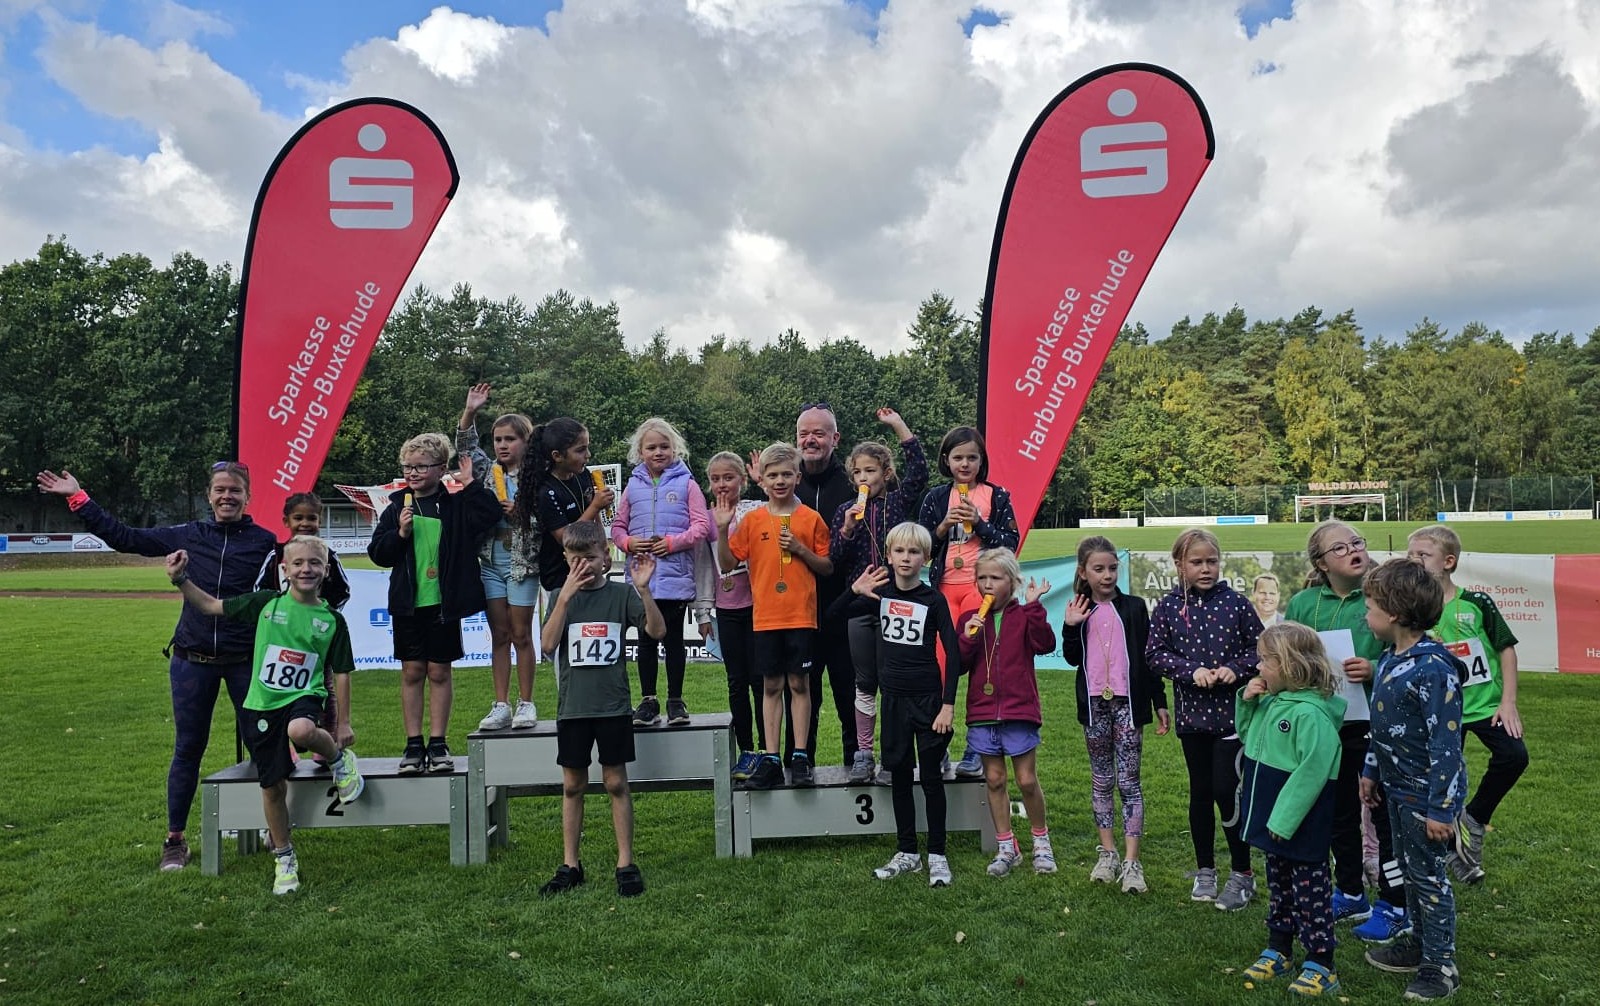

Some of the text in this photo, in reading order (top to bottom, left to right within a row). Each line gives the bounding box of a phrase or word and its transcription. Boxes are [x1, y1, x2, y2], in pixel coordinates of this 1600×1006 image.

[1015, 287, 1081, 397] Sparkasse
[1018, 249, 1134, 462] Harburg-Buxtehude
[268, 316, 331, 426] Sparkasse
[272, 281, 381, 491] Harburg-Buxtehude
[1308, 480, 1389, 491] WALDSTADION
[1495, 585, 1528, 596] Sport-
[1524, 598, 1545, 608] den
[881, 615, 921, 642] 235
[572, 639, 617, 662] 142
[264, 662, 310, 690] 180
[325, 786, 346, 817] 2
[855, 794, 875, 825] 3
